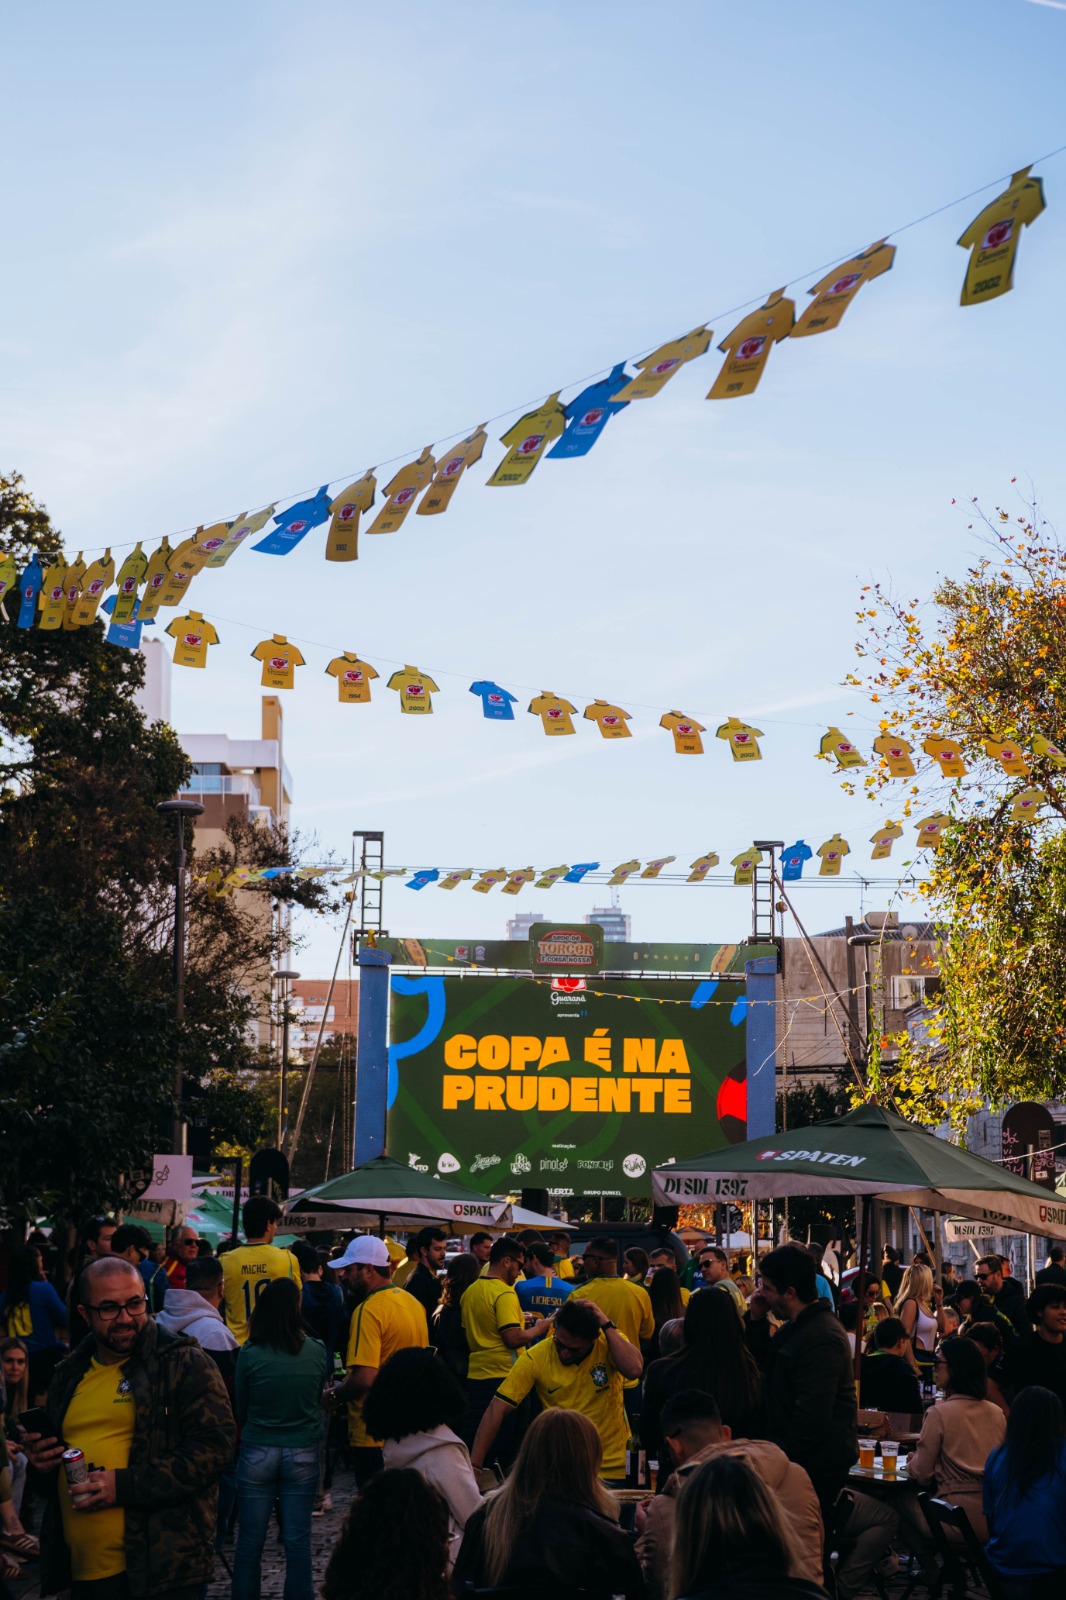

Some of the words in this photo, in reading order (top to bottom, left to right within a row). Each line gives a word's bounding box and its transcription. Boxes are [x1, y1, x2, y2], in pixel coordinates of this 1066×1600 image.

[973, 275, 1001, 295] 2002
[547, 956, 568, 964] COISA
[568, 956, 592, 964] NOSSA
[550, 991, 587, 1006] Guaraná
[444, 1034, 571, 1071] COPA
[584, 1028, 612, 1072] É
[623, 1038, 691, 1074] NA
[443, 1075, 692, 1114] PRUDENTE
[774, 1150, 867, 1168] SPATEN
[715, 1178, 749, 1196] 1397
[978, 1225, 995, 1236] 1397
[240, 1263, 267, 1275] MICHE
[531, 1295, 563, 1307] LICHESKI
